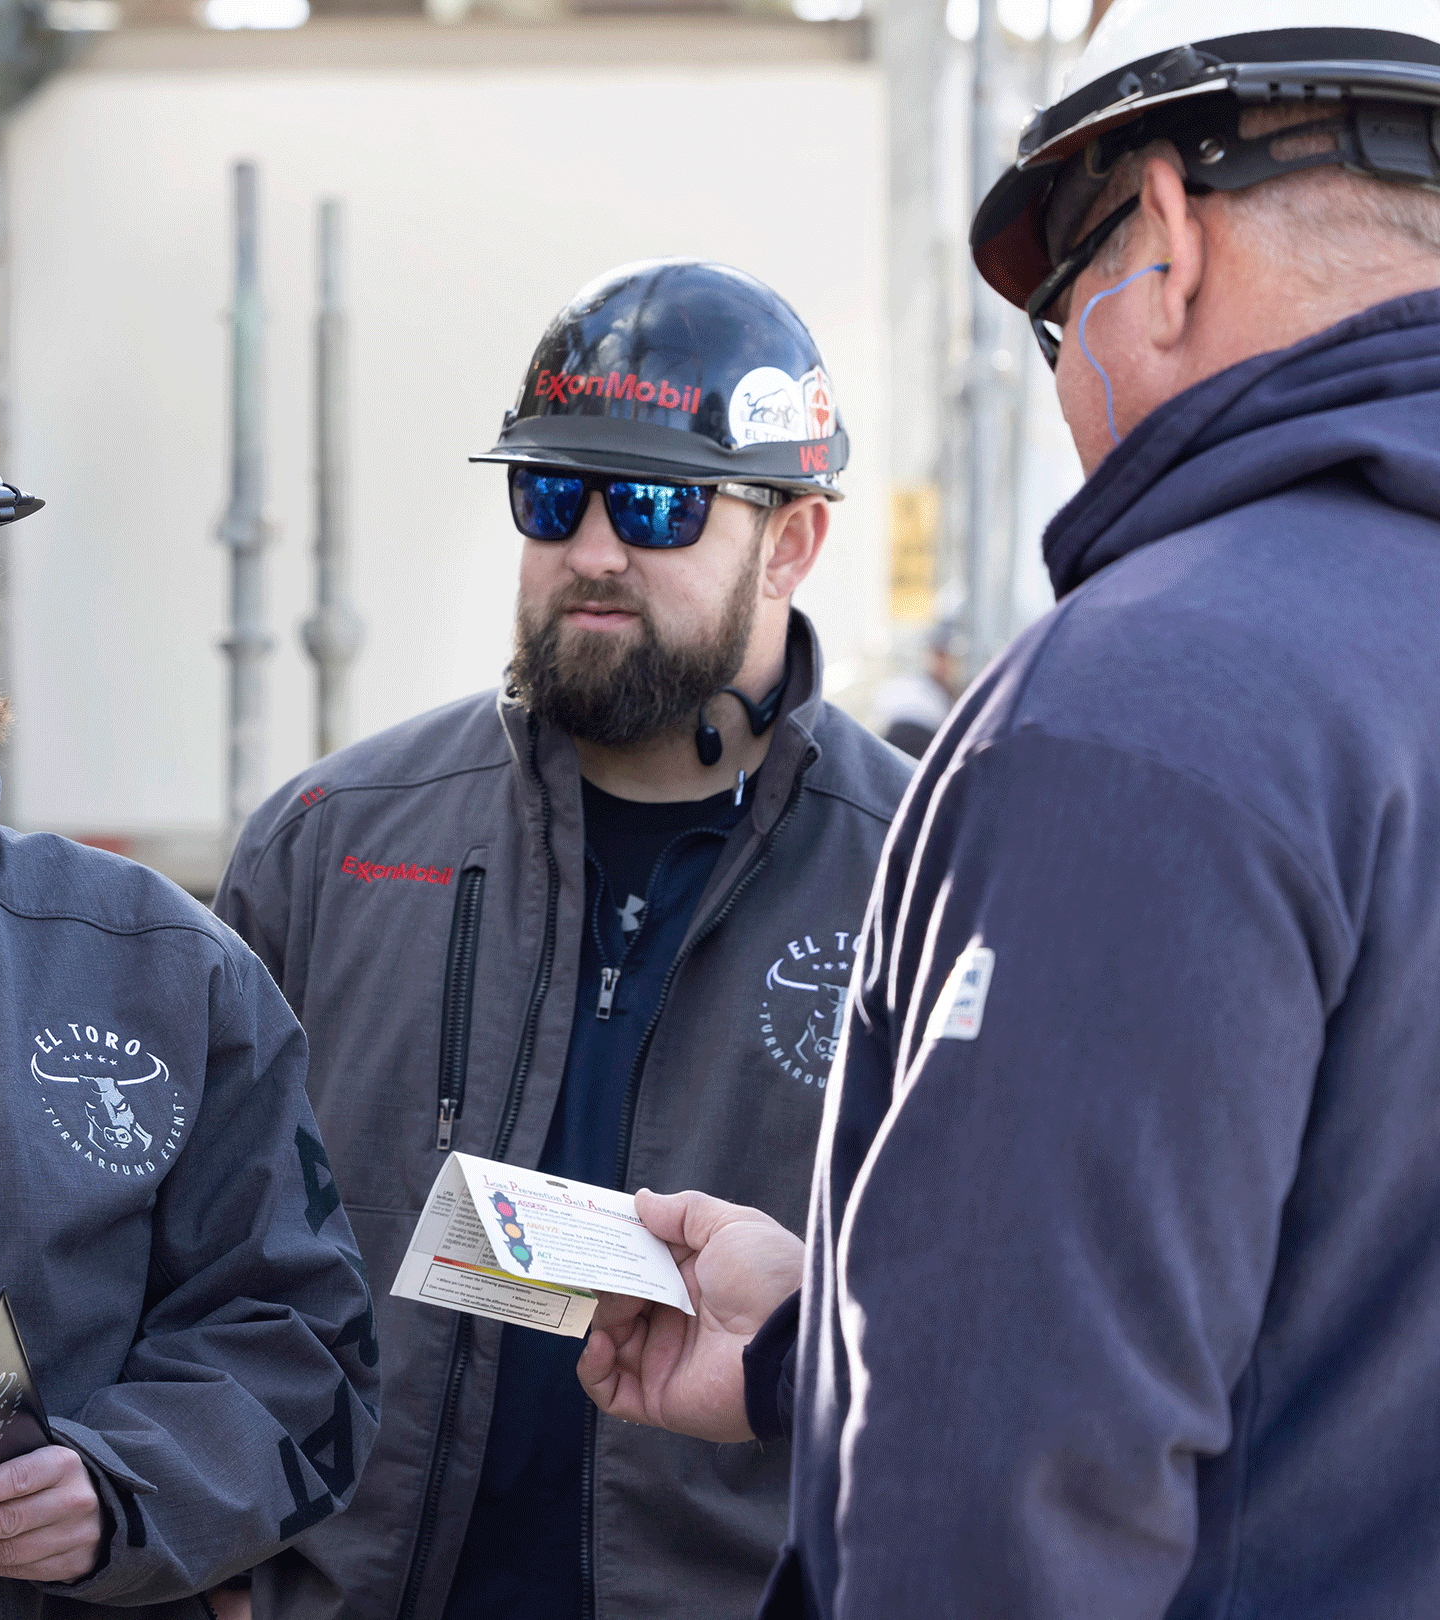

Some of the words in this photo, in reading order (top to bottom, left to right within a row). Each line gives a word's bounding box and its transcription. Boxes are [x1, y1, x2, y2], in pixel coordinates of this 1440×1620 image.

[534, 369, 702, 415] ExxonMobil
[341, 855, 453, 885] ExxonMobil
[787, 936, 821, 961] EL
[35, 1028, 62, 1054] EL
[68, 1023, 141, 1056] TORO
[759, 1012, 827, 1089] TURNAROU
[44, 1106, 157, 1177] TURNAROUND
[160, 1103, 186, 1161] EVENT
[508, 1180, 562, 1202] Prevention
[516, 1198, 548, 1212] ASSESS
[535, 1249, 552, 1259] ACT
